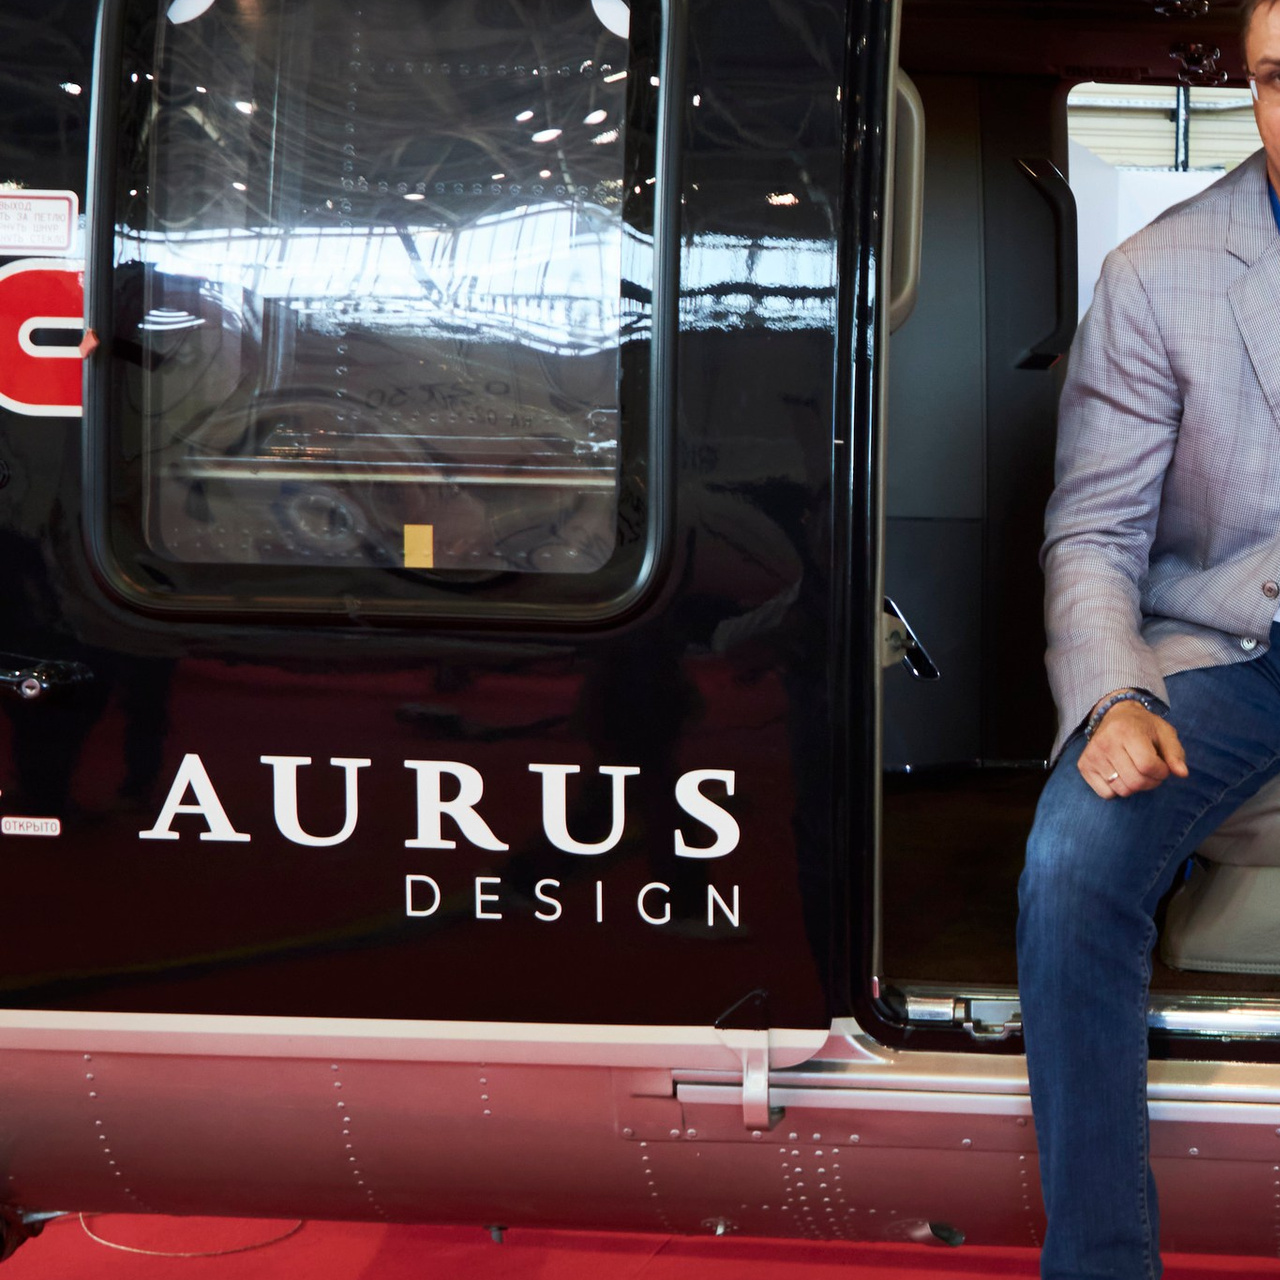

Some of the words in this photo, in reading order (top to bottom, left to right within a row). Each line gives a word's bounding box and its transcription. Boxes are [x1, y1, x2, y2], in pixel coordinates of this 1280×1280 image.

[16, 212, 28, 222] ЗА
[34, 213, 66, 222] ПЕТЛЮ
[138, 753, 741, 859] AURUS
[4, 820, 58, 833] ОТКРЫТО
[405, 874, 740, 928] DESIGN
